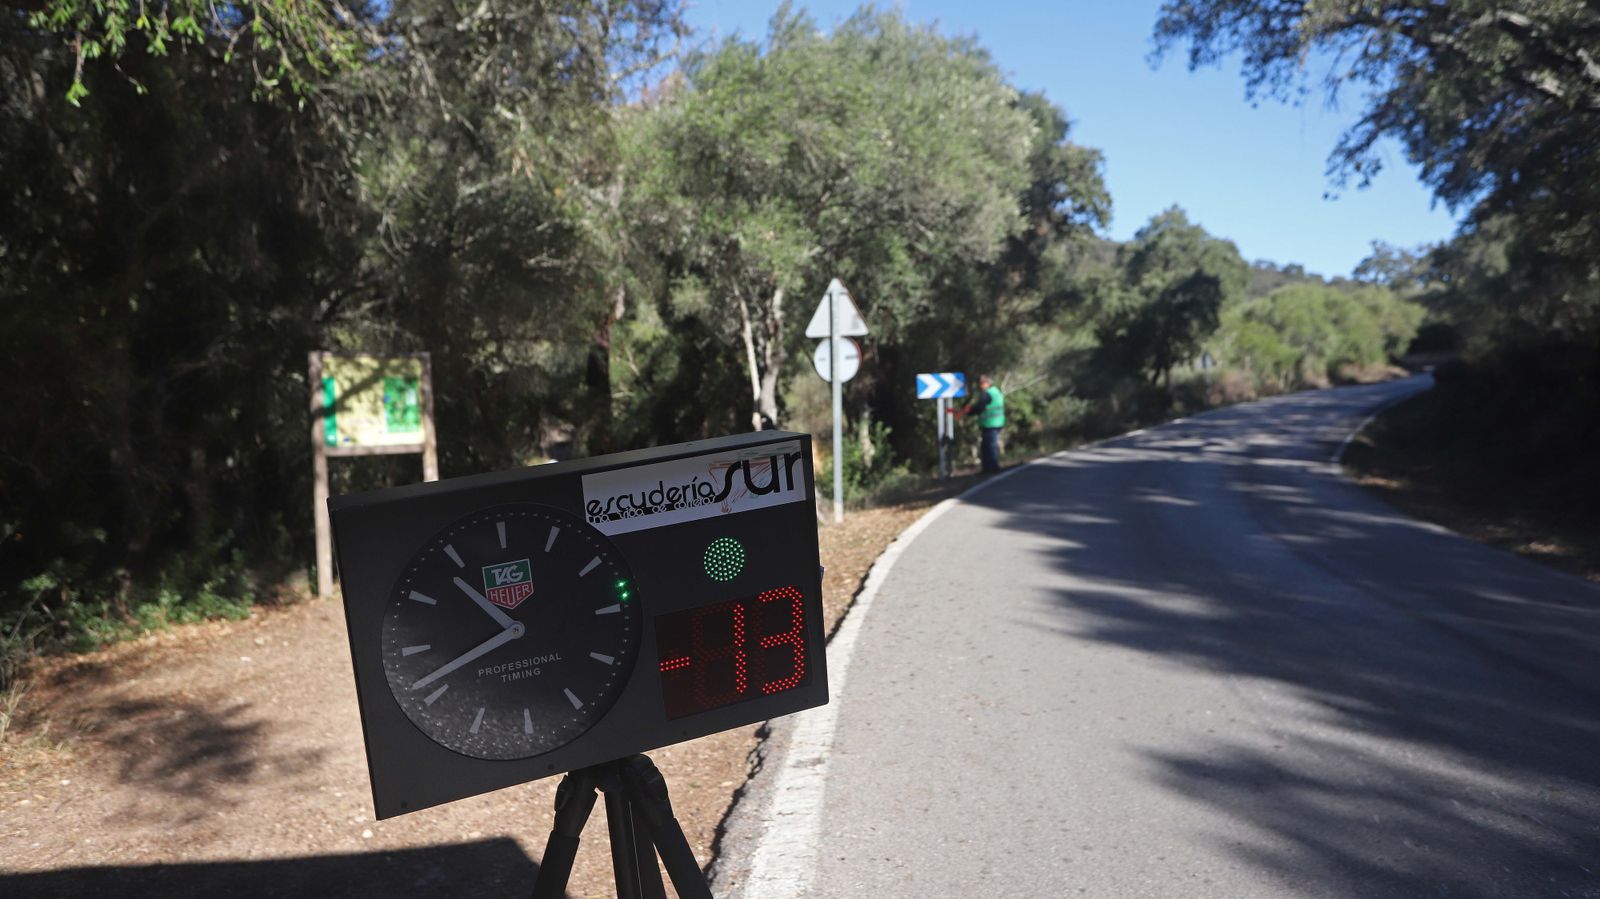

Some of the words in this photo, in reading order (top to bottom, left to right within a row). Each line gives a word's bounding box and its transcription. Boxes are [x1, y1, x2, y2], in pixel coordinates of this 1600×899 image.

[586, 476, 714, 515] escudería
[714, 452, 801, 502] sur
[491, 564, 524, 586] TAG
[489, 583, 531, 606] HEUER
[478, 652, 563, 678] PROFESSIONAL
[501, 667, 541, 684] TIMING
